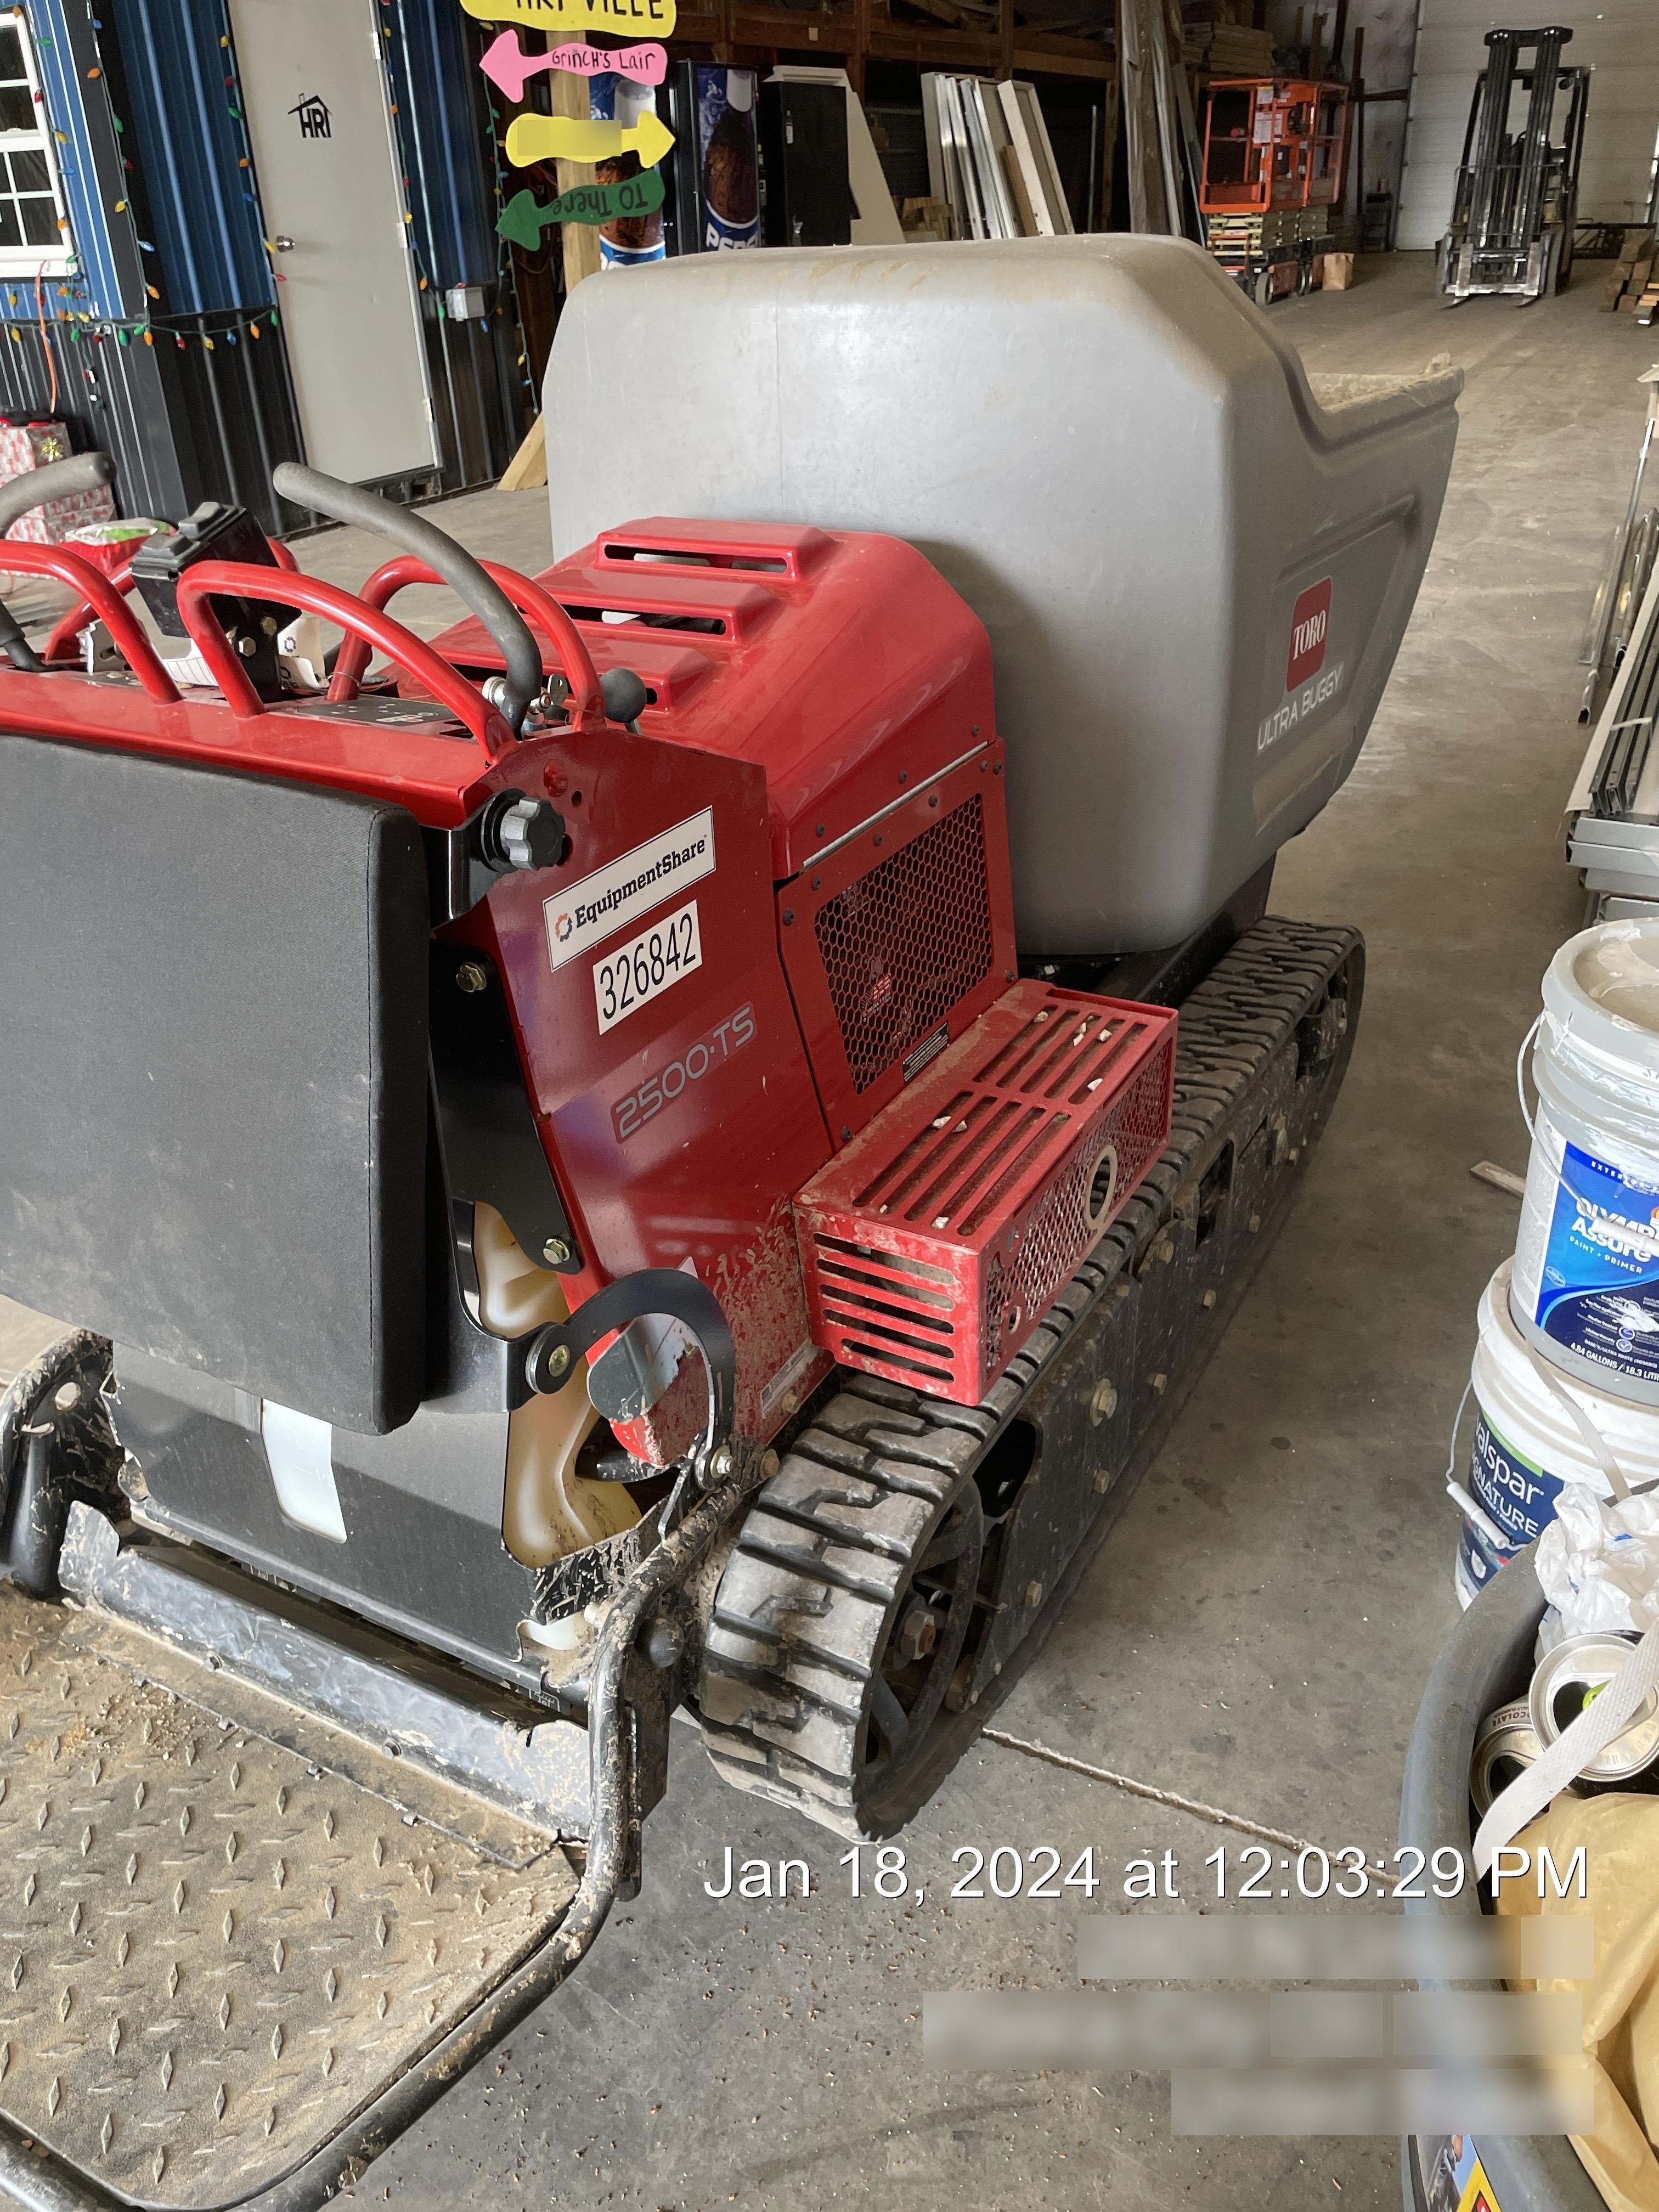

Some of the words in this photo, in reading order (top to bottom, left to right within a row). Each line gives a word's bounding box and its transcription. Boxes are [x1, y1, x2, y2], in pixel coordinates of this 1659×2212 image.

[619, 52, 656, 70] Lair
[1293, 610, 1327, 661] TORO
[1258, 700, 1298, 751] ULTRA
[1302, 663, 1344, 718] BUGGY
[600, 913, 696, 1019] 326842
[1570, 1235, 1595, 1254] PAINT
[1604, 1254, 1643, 1274] PRIMER
[1570, 1342, 1585, 1356] 4.84
[1585, 1350, 1618, 1369] GALLONS
[1624, 1365, 1643, 1377] 18.3
[1476, 1413, 1541, 1505] valspar
